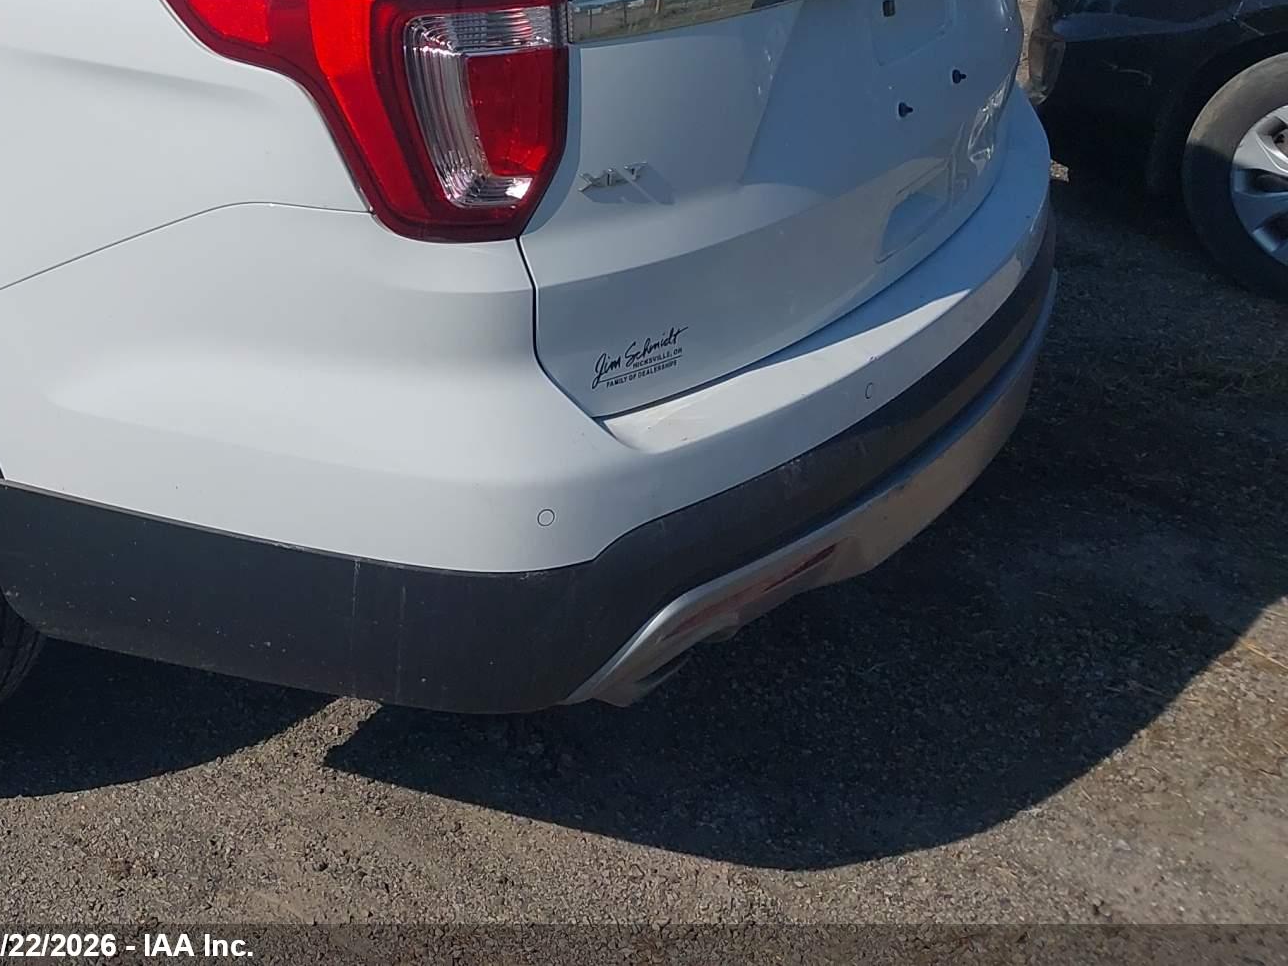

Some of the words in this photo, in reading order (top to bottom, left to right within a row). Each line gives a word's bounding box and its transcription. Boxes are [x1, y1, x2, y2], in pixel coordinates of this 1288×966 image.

[578, 161, 648, 191] XLT
[592, 353, 621, 389] Jim
[625, 327, 689, 367] Schmidt
[606, 376, 628, 388] FAMILY
